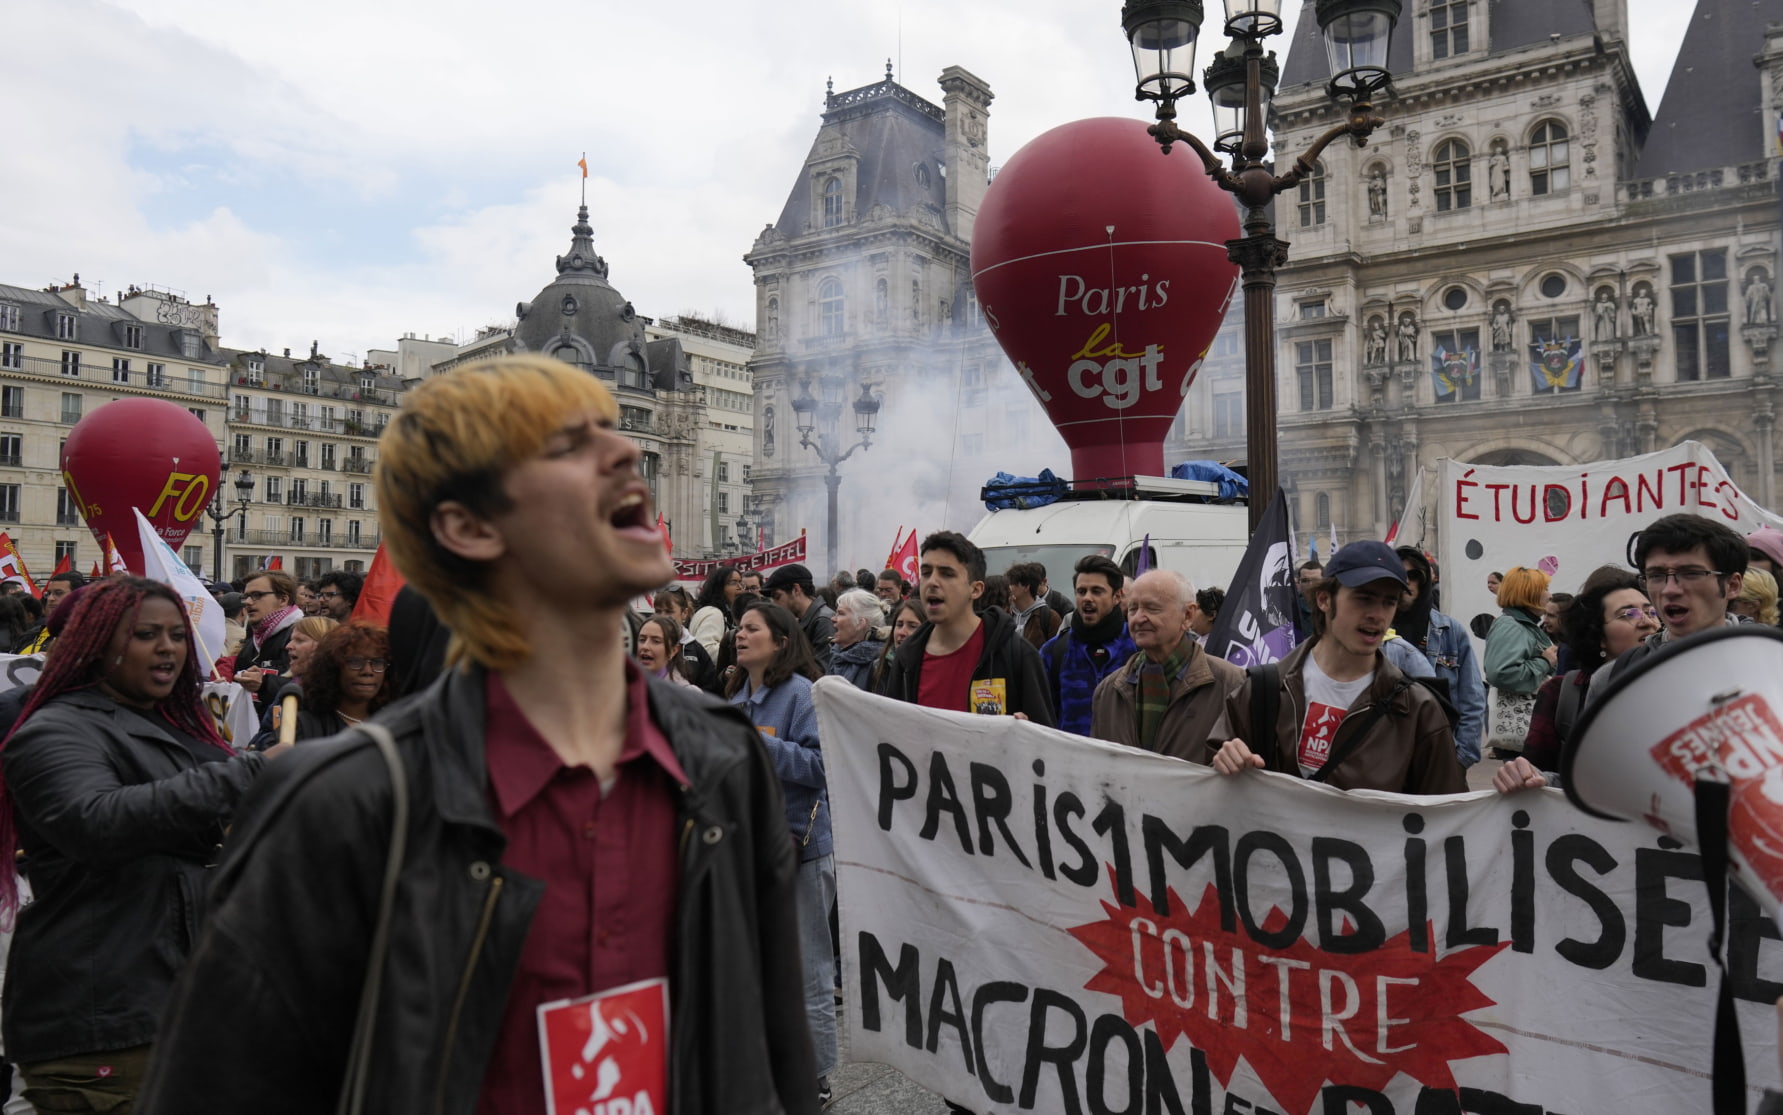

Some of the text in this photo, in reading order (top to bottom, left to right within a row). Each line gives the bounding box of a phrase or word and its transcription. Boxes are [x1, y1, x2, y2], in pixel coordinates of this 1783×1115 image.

[1054, 273, 1170, 316] Paris
[1071, 323, 1164, 360] la
[1067, 343, 1164, 409] cgt
[147, 471, 208, 522] FO
[1306, 735, 1331, 753] NP
[1129, 916, 1420, 1065] CONTRE
[858, 930, 1212, 1115] MACRON
